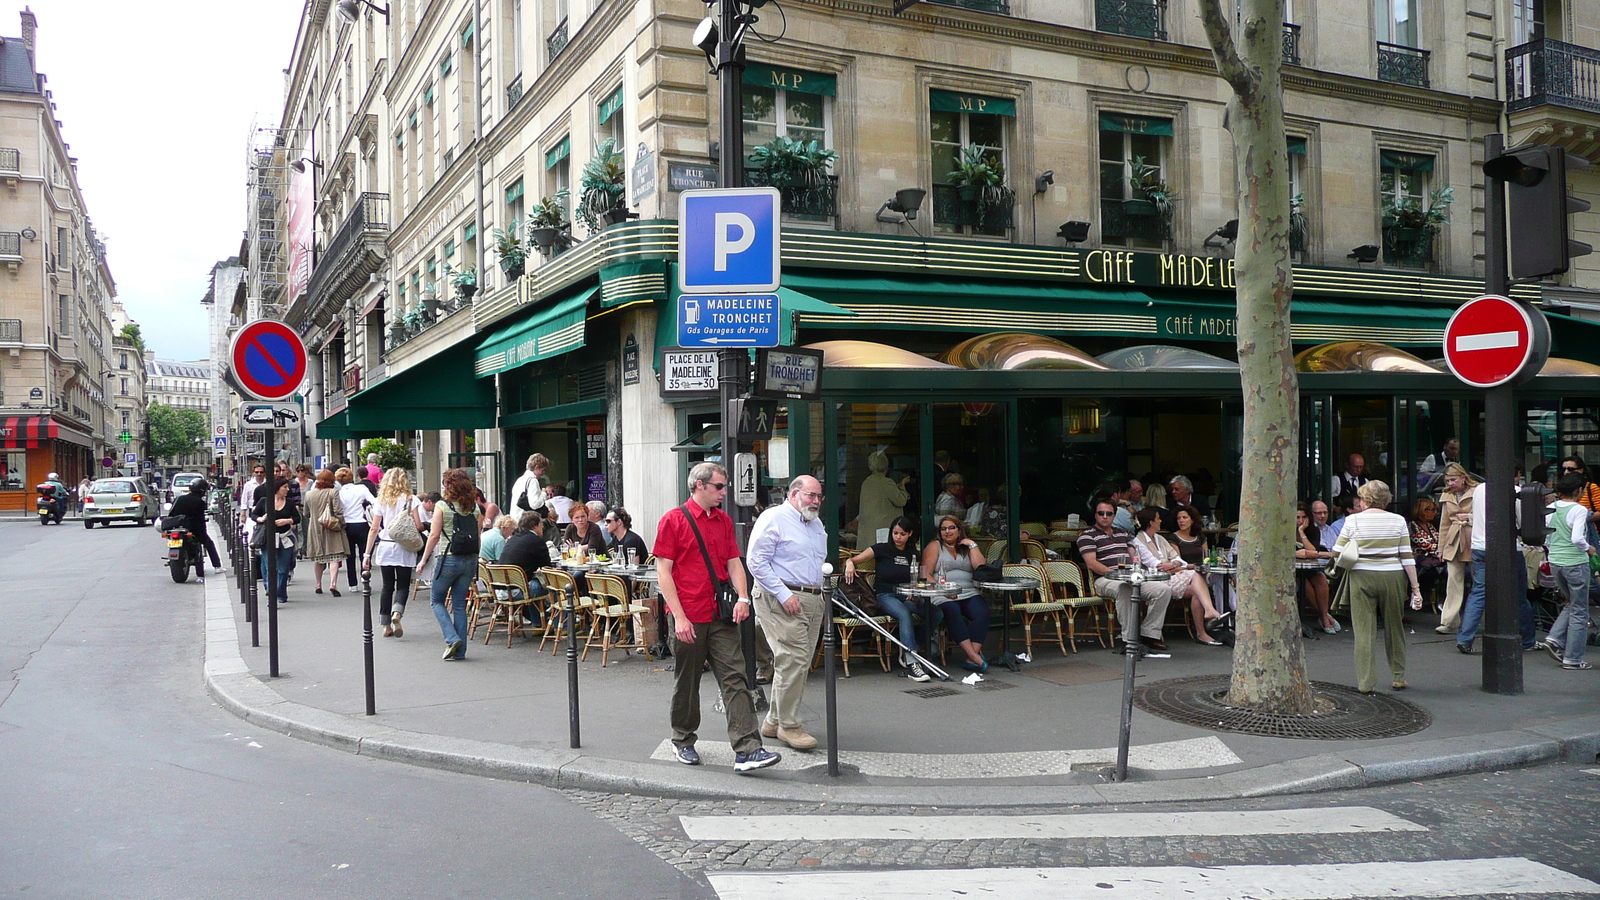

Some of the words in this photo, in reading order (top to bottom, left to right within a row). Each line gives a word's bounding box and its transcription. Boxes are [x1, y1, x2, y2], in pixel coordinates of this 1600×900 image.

[685, 168, 704, 178] RUE
[673, 178, 717, 188] TRONCHET
[714, 212, 756, 272] P
[1085, 250, 1136, 283] CAFE
[707, 299, 772, 309] MADELEINE
[712, 313, 772, 323] TRONCHET
[1165, 314, 1194, 335] CAFÉ
[687, 326, 701, 334] Gds
[703, 326, 734, 336] Garages
[737, 326, 747, 334] de
[749, 326, 769, 334] Paris
[669, 355, 692, 364] PLACE
[693, 354, 703, 364] DE
[705, 354, 715, 363] LA
[785, 356, 803, 367] RUE
[671, 365, 712, 378] MADELEINE
[770, 366, 816, 382] TRONCHET
[669, 379, 680, 389] 35
[703, 378, 715, 388] 30
